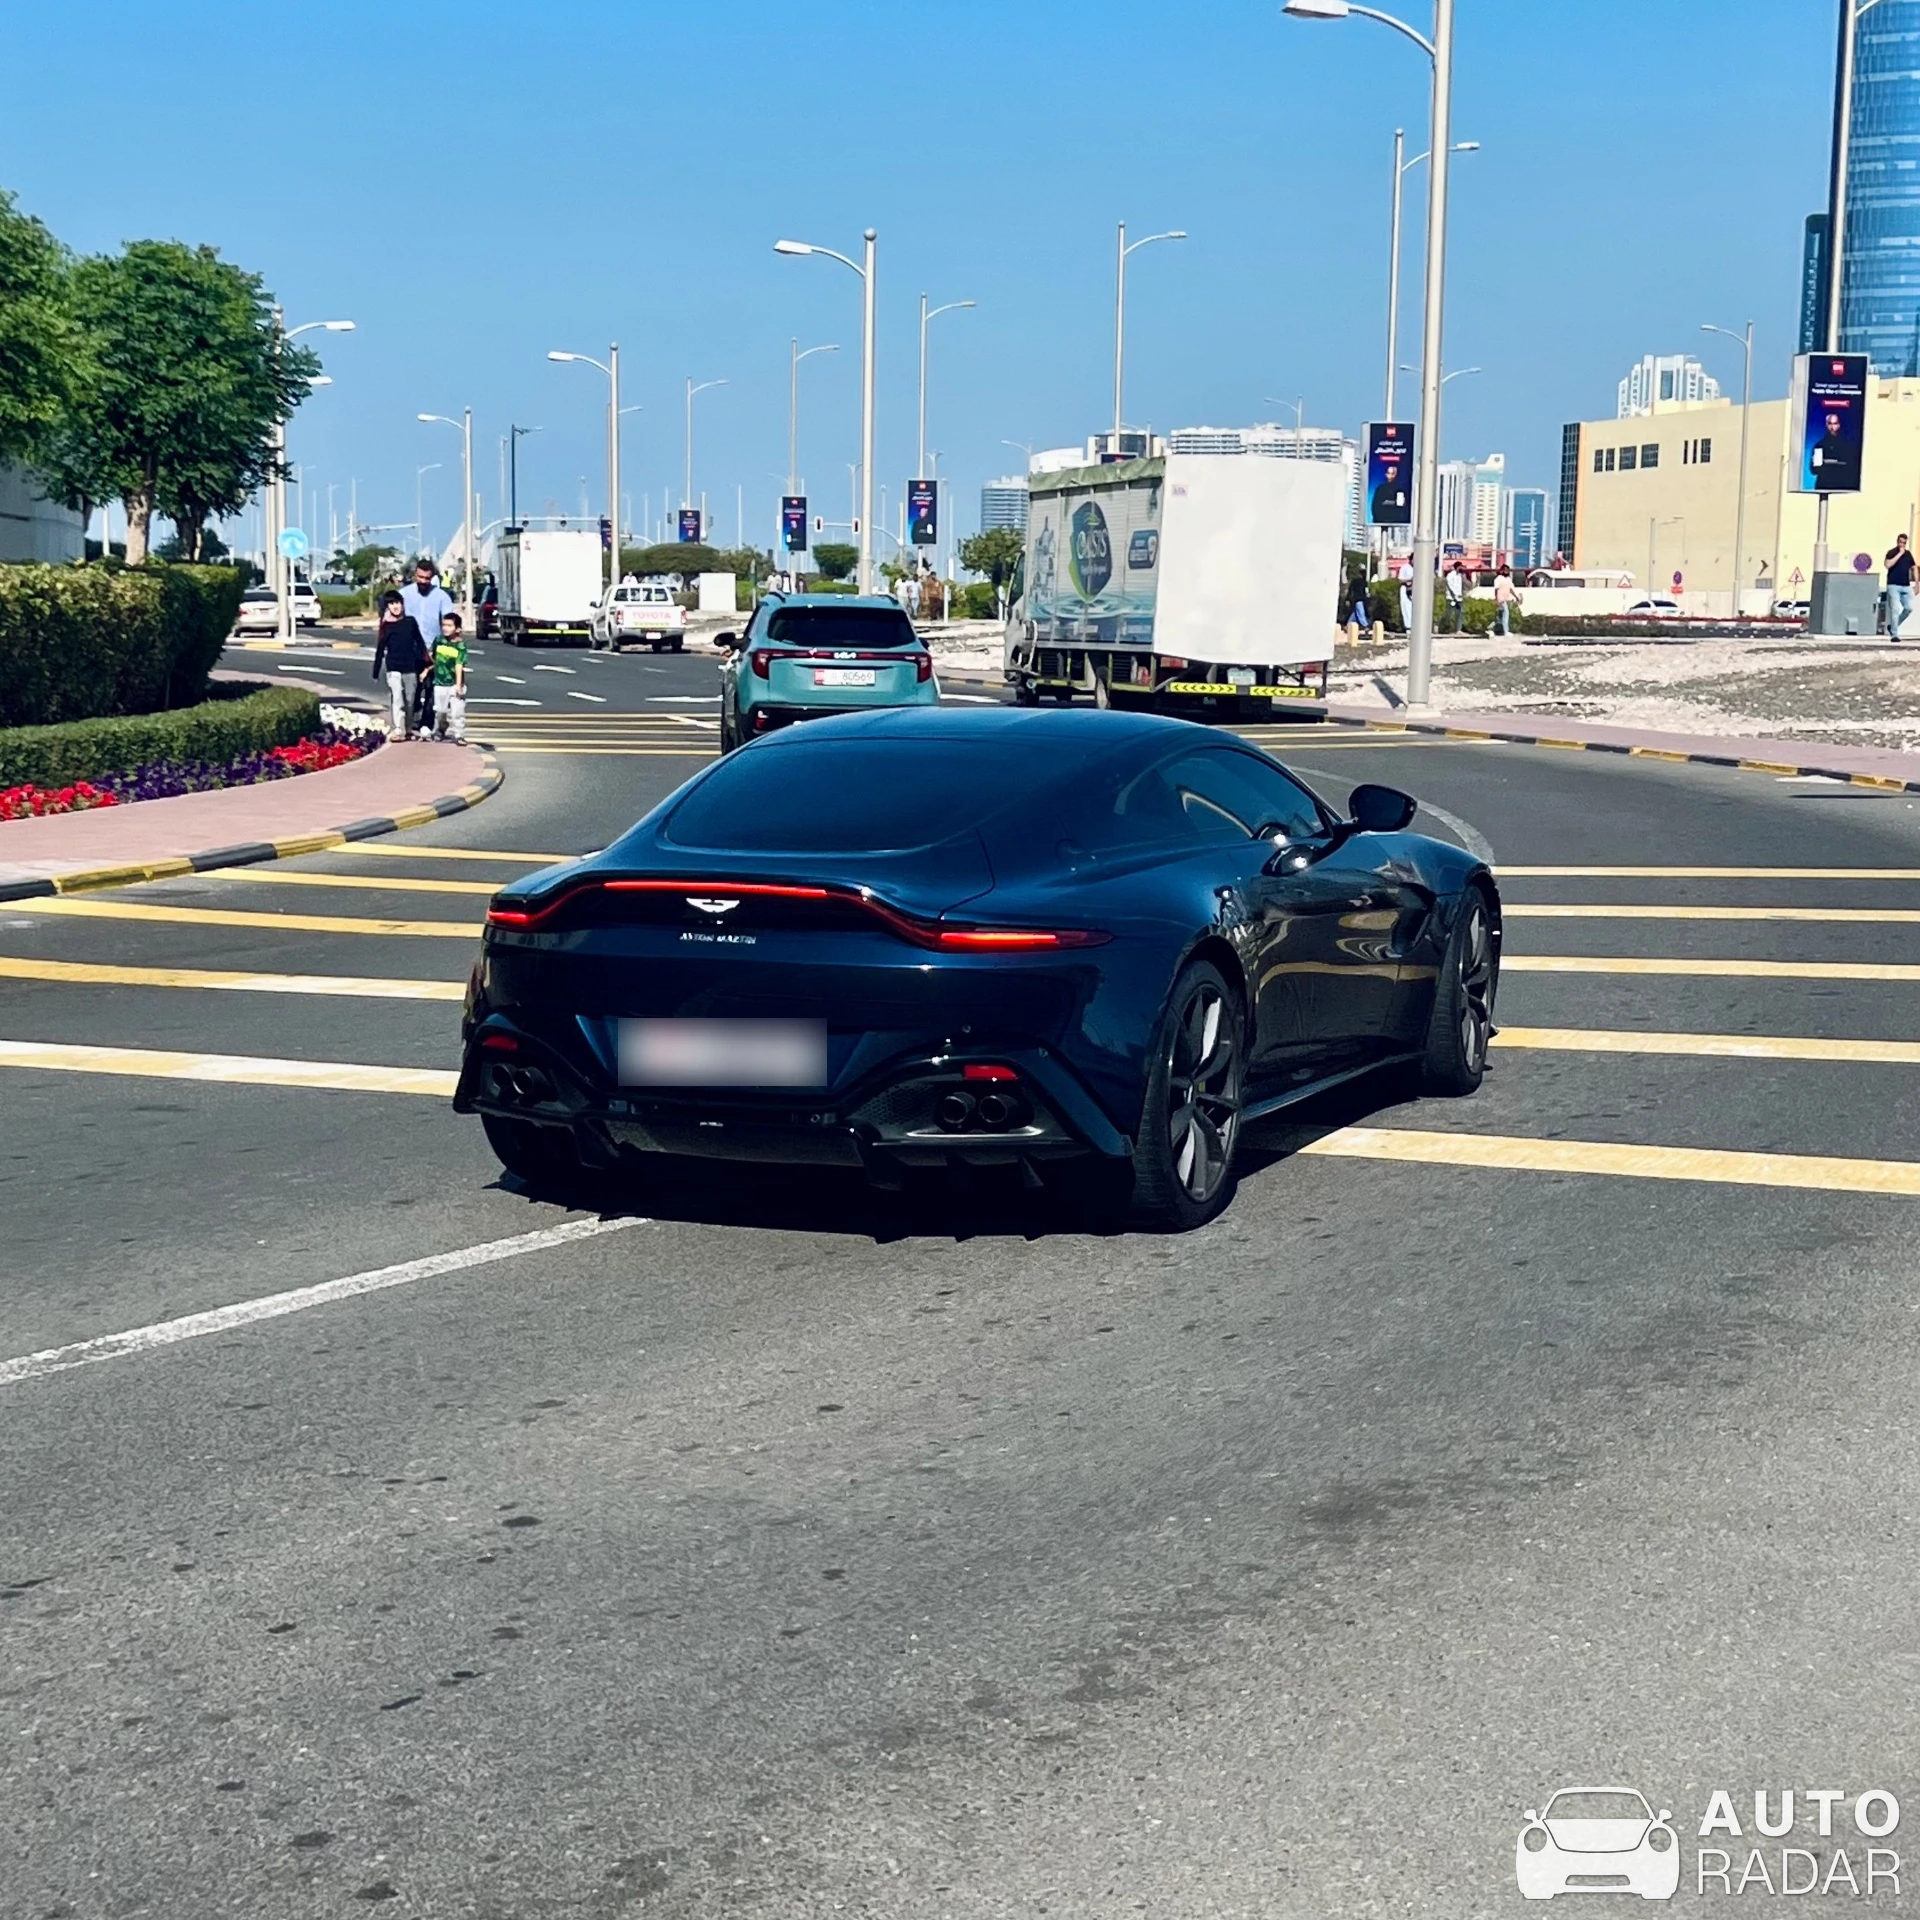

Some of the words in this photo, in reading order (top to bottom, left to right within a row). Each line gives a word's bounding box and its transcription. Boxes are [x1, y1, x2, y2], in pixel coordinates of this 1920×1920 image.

[632, 611, 671, 619] TOYOTA
[833, 651, 857, 659] KIA
[680, 932, 714, 942] ASTON
[717, 935, 756, 944] MARTIN
